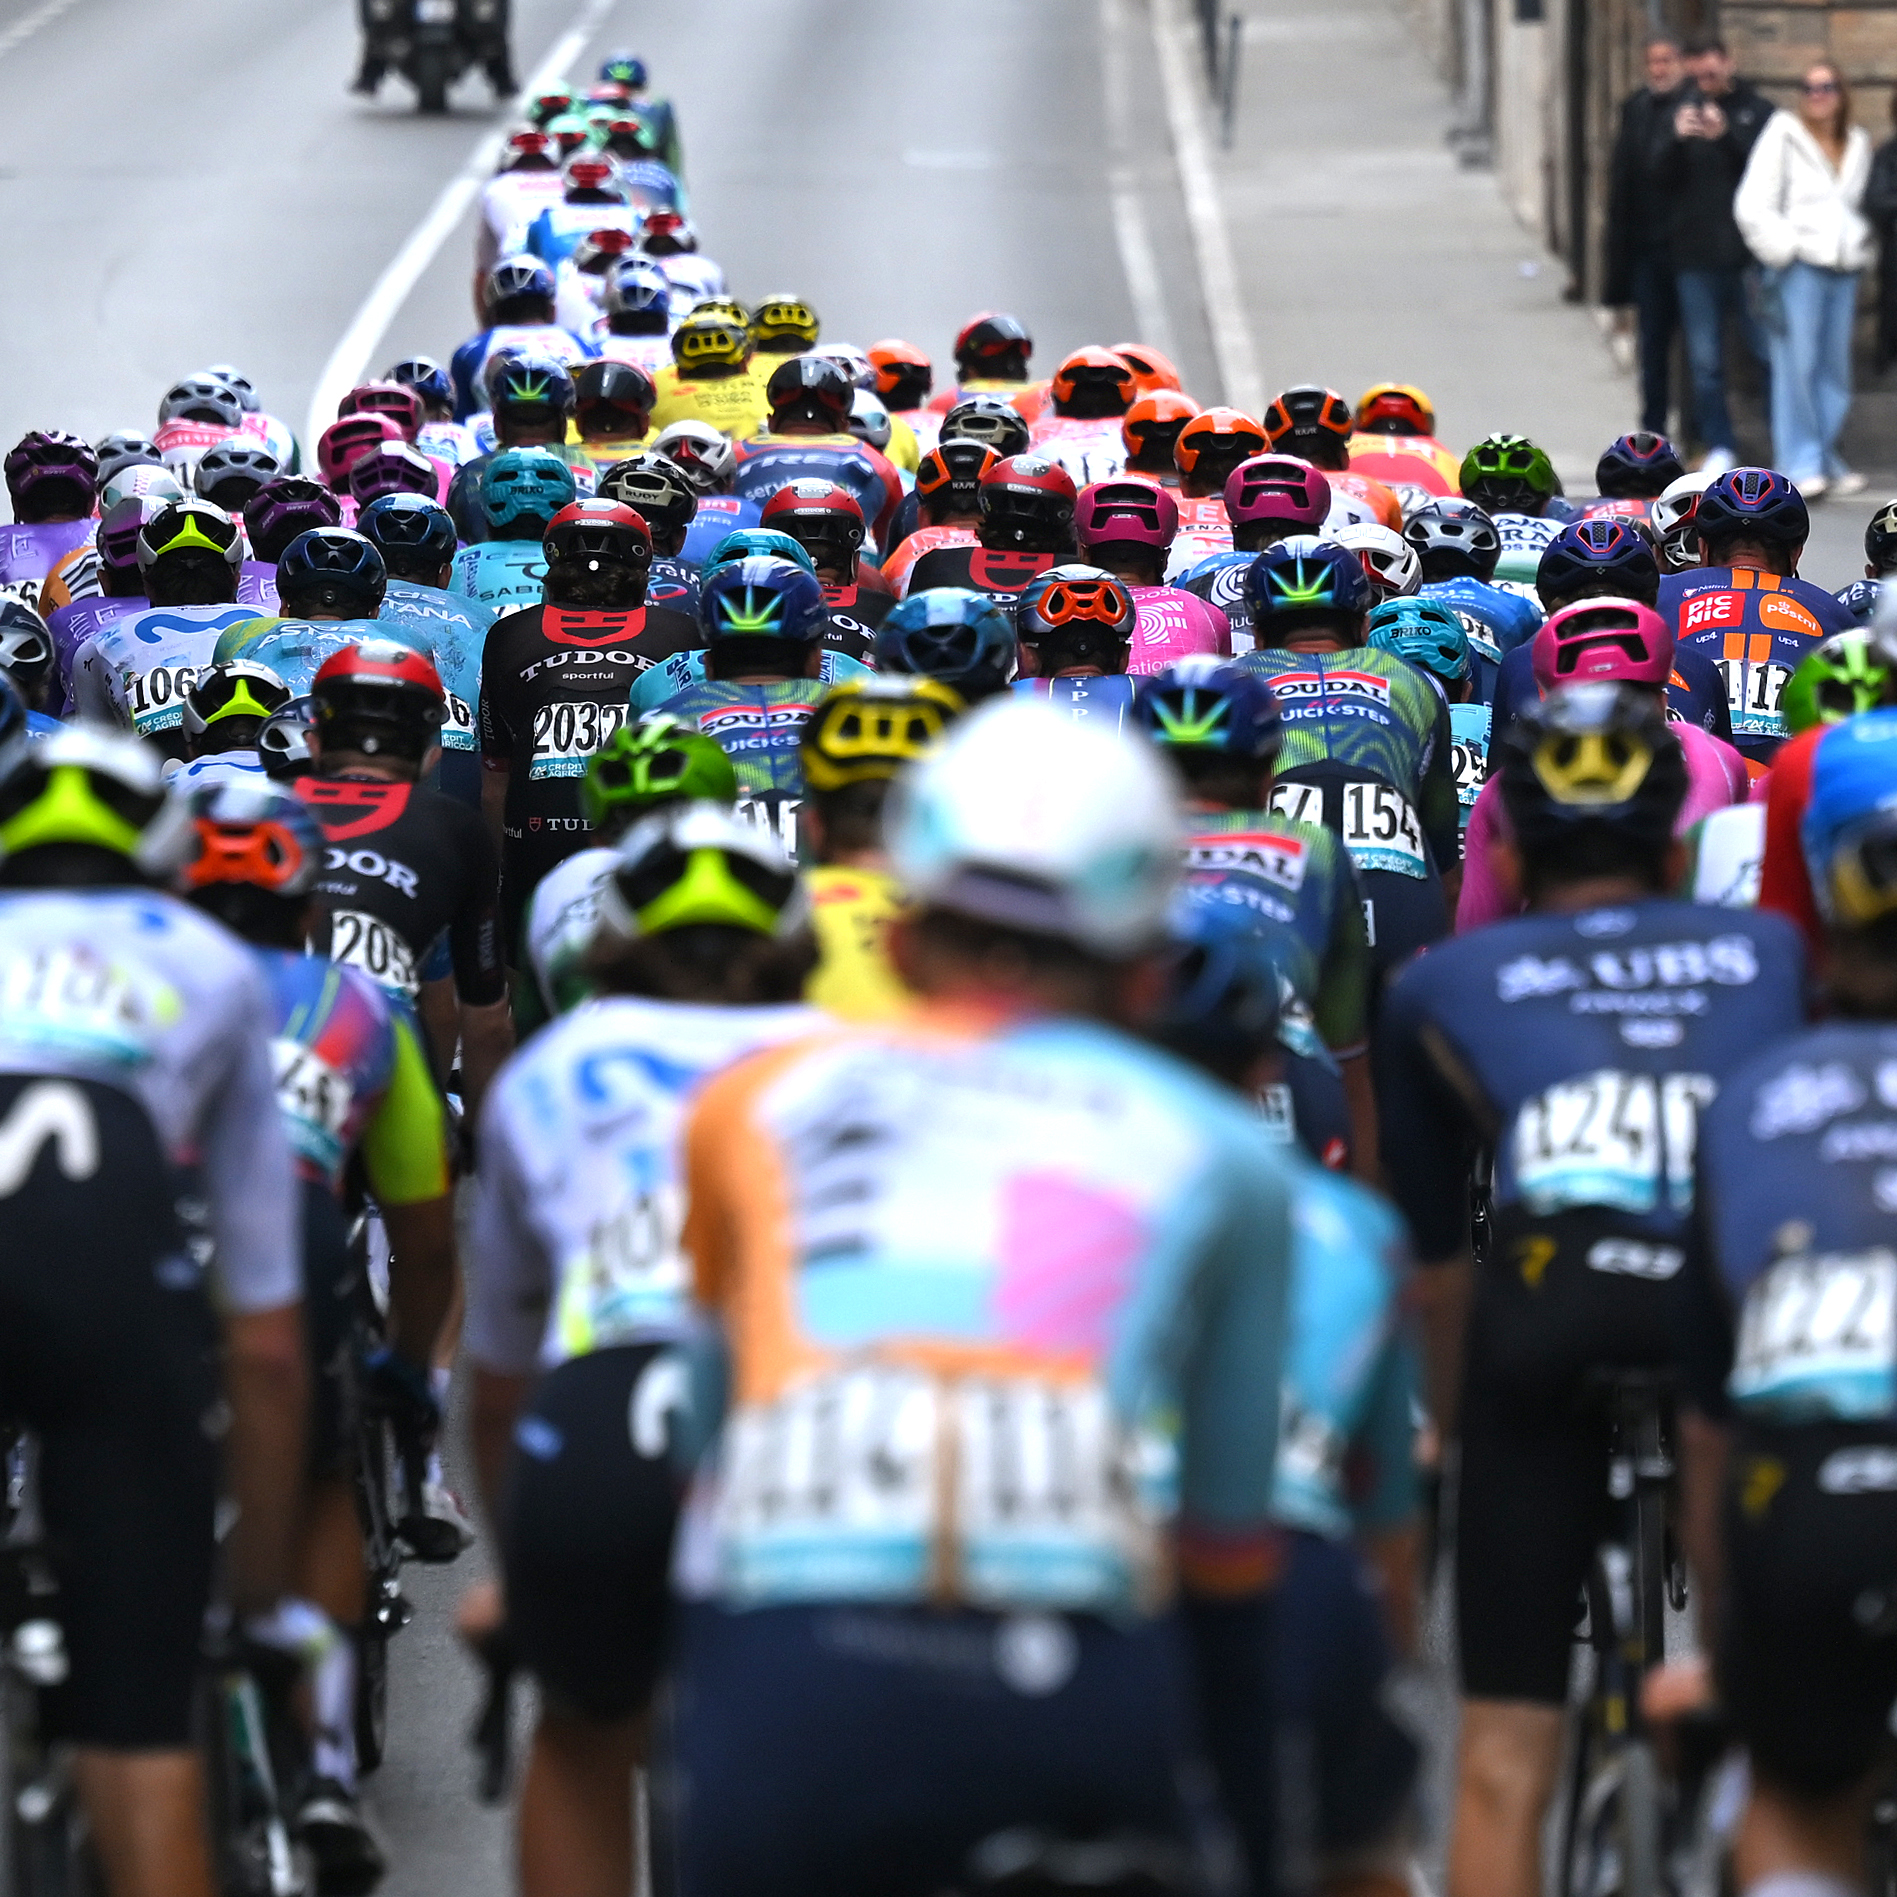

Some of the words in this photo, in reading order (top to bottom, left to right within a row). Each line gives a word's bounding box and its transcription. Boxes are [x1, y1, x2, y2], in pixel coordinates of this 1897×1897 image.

[509, 485, 544, 496] BRIKO
[625, 490, 659, 500] RUDY
[1497, 518, 1552, 533] AJA
[382, 600, 473, 630] TANA
[1389, 626, 1432, 639] BRIKO
[561, 671, 615, 682] sportful
[1125, 660, 1174, 676] ation
[130, 666, 197, 715] 106
[1270, 681, 1388, 708] OUDAL
[533, 702, 598, 754] 203
[1347, 784, 1418, 852] 154
[324, 848, 420, 900] DOR
